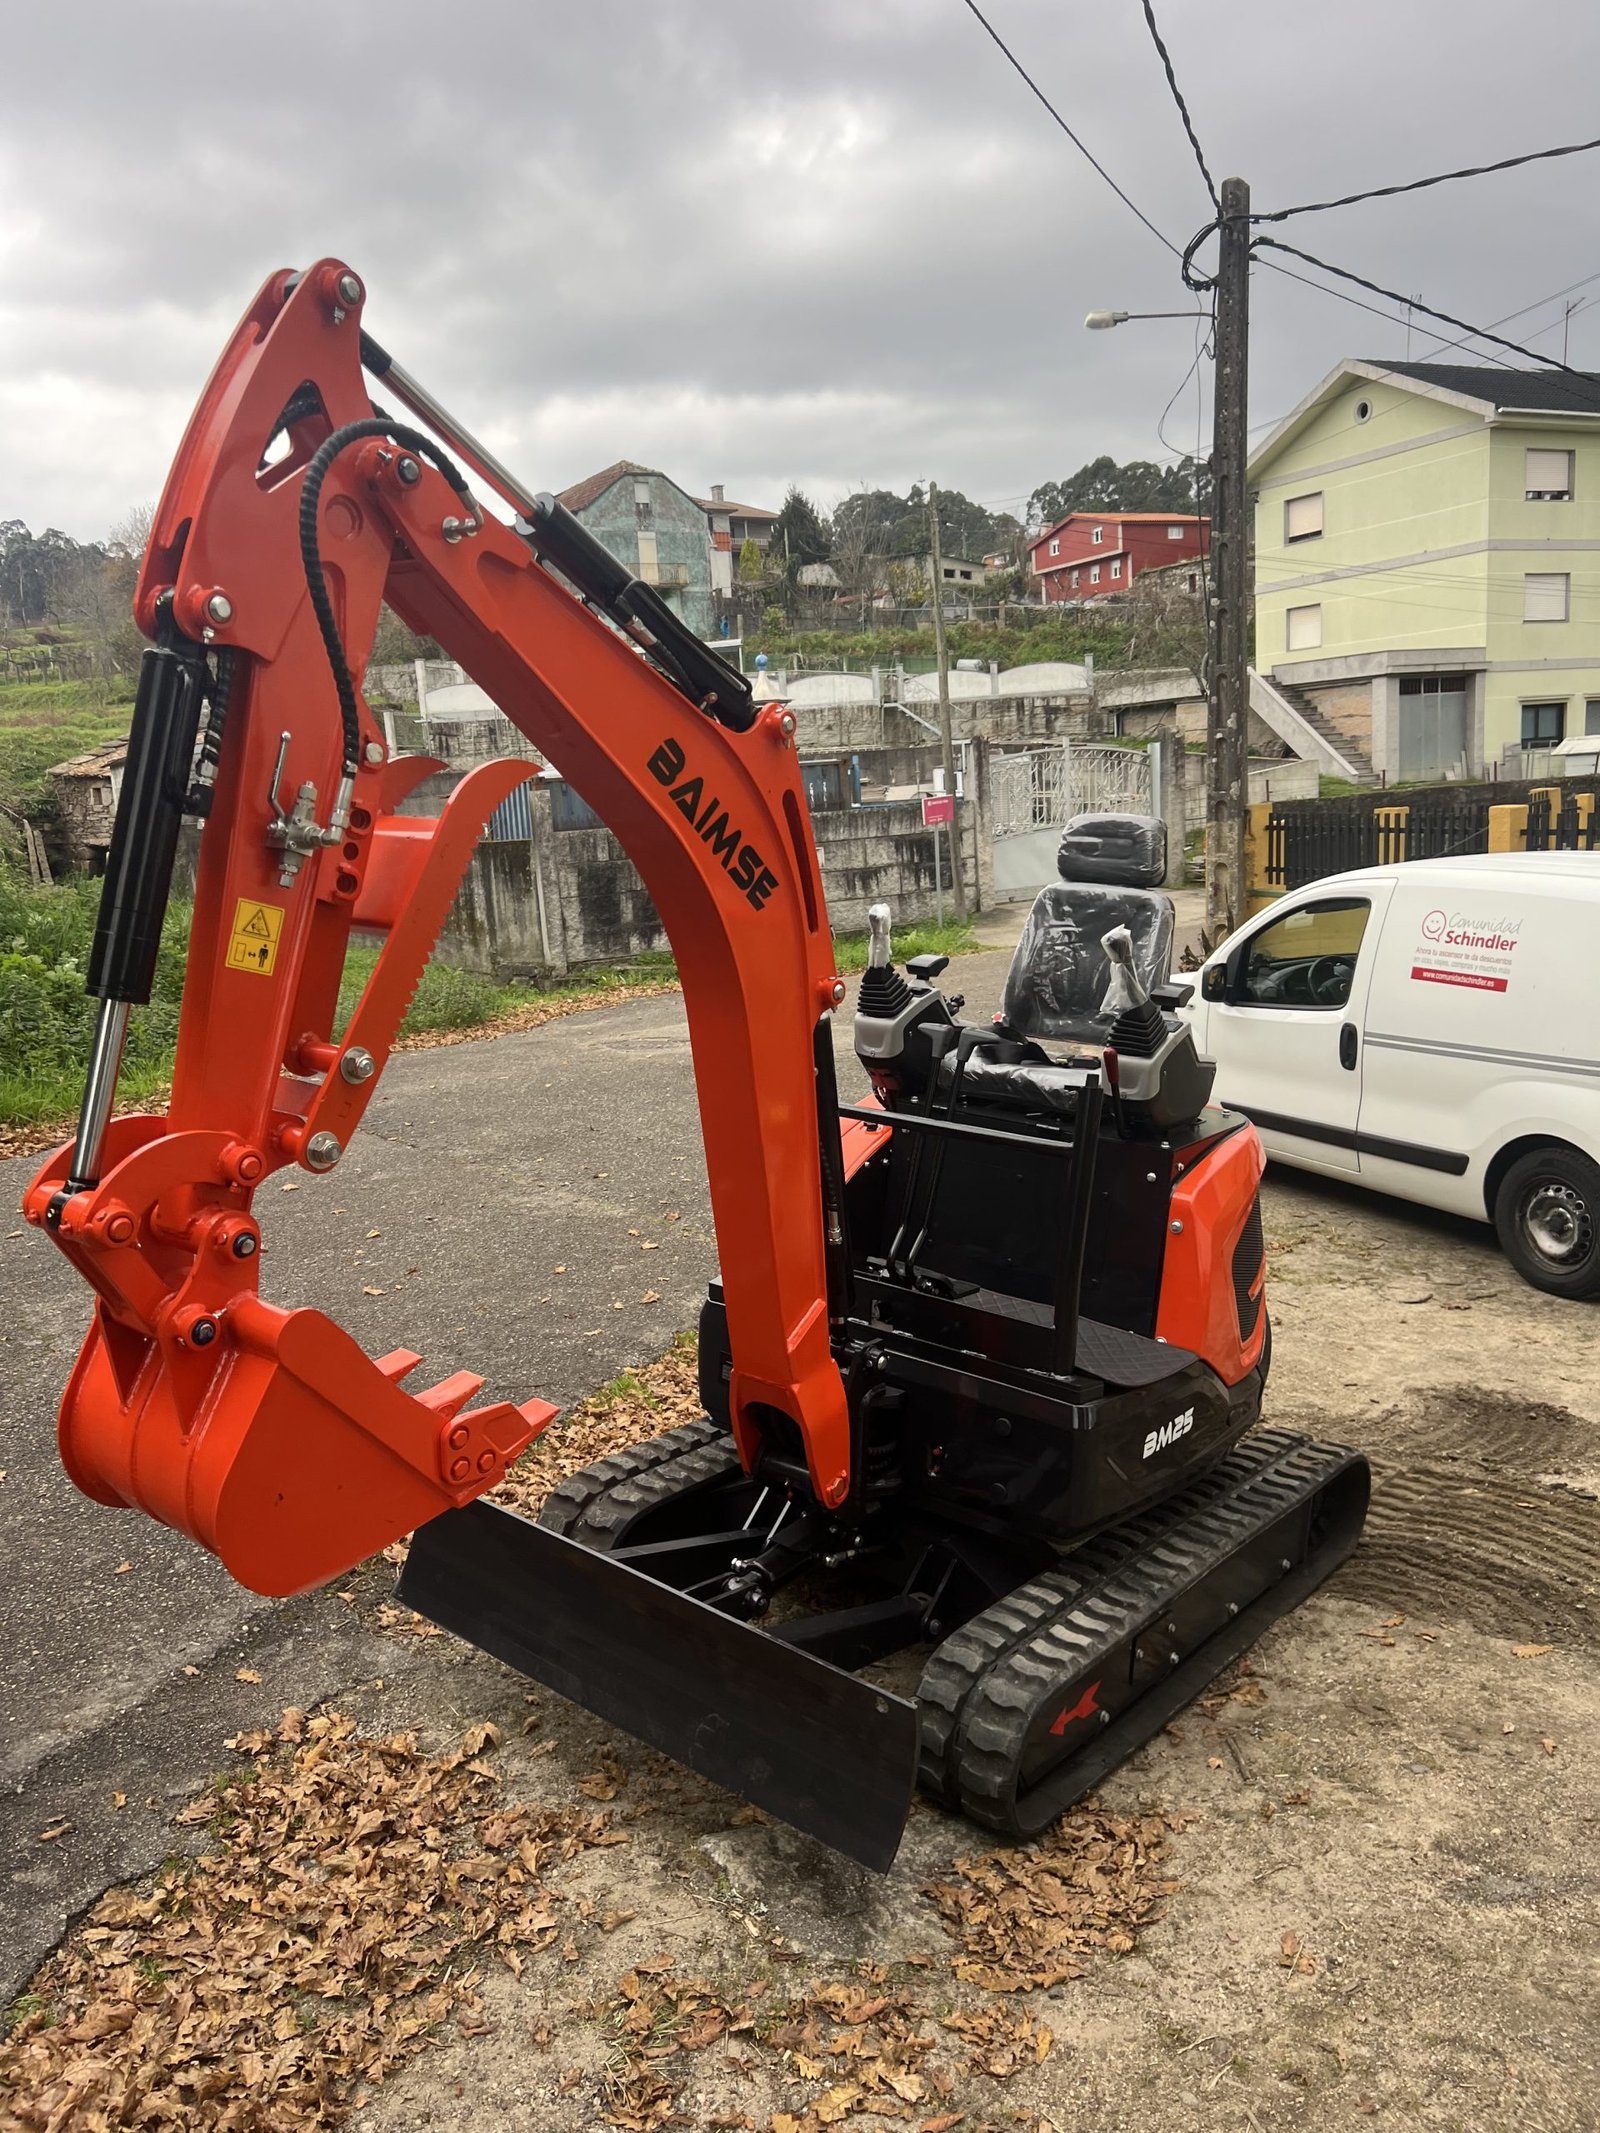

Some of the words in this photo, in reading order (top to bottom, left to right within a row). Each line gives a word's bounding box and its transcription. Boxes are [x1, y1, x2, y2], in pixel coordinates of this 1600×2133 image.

[647, 738, 779, 911] BAIMSE
[1449, 912, 1523, 934] Comunidad
[1445, 930, 1517, 951] Schindler
[1422, 970, 1495, 987] www.comunidadschindler.es
[1143, 1406, 1194, 1459] BM25
